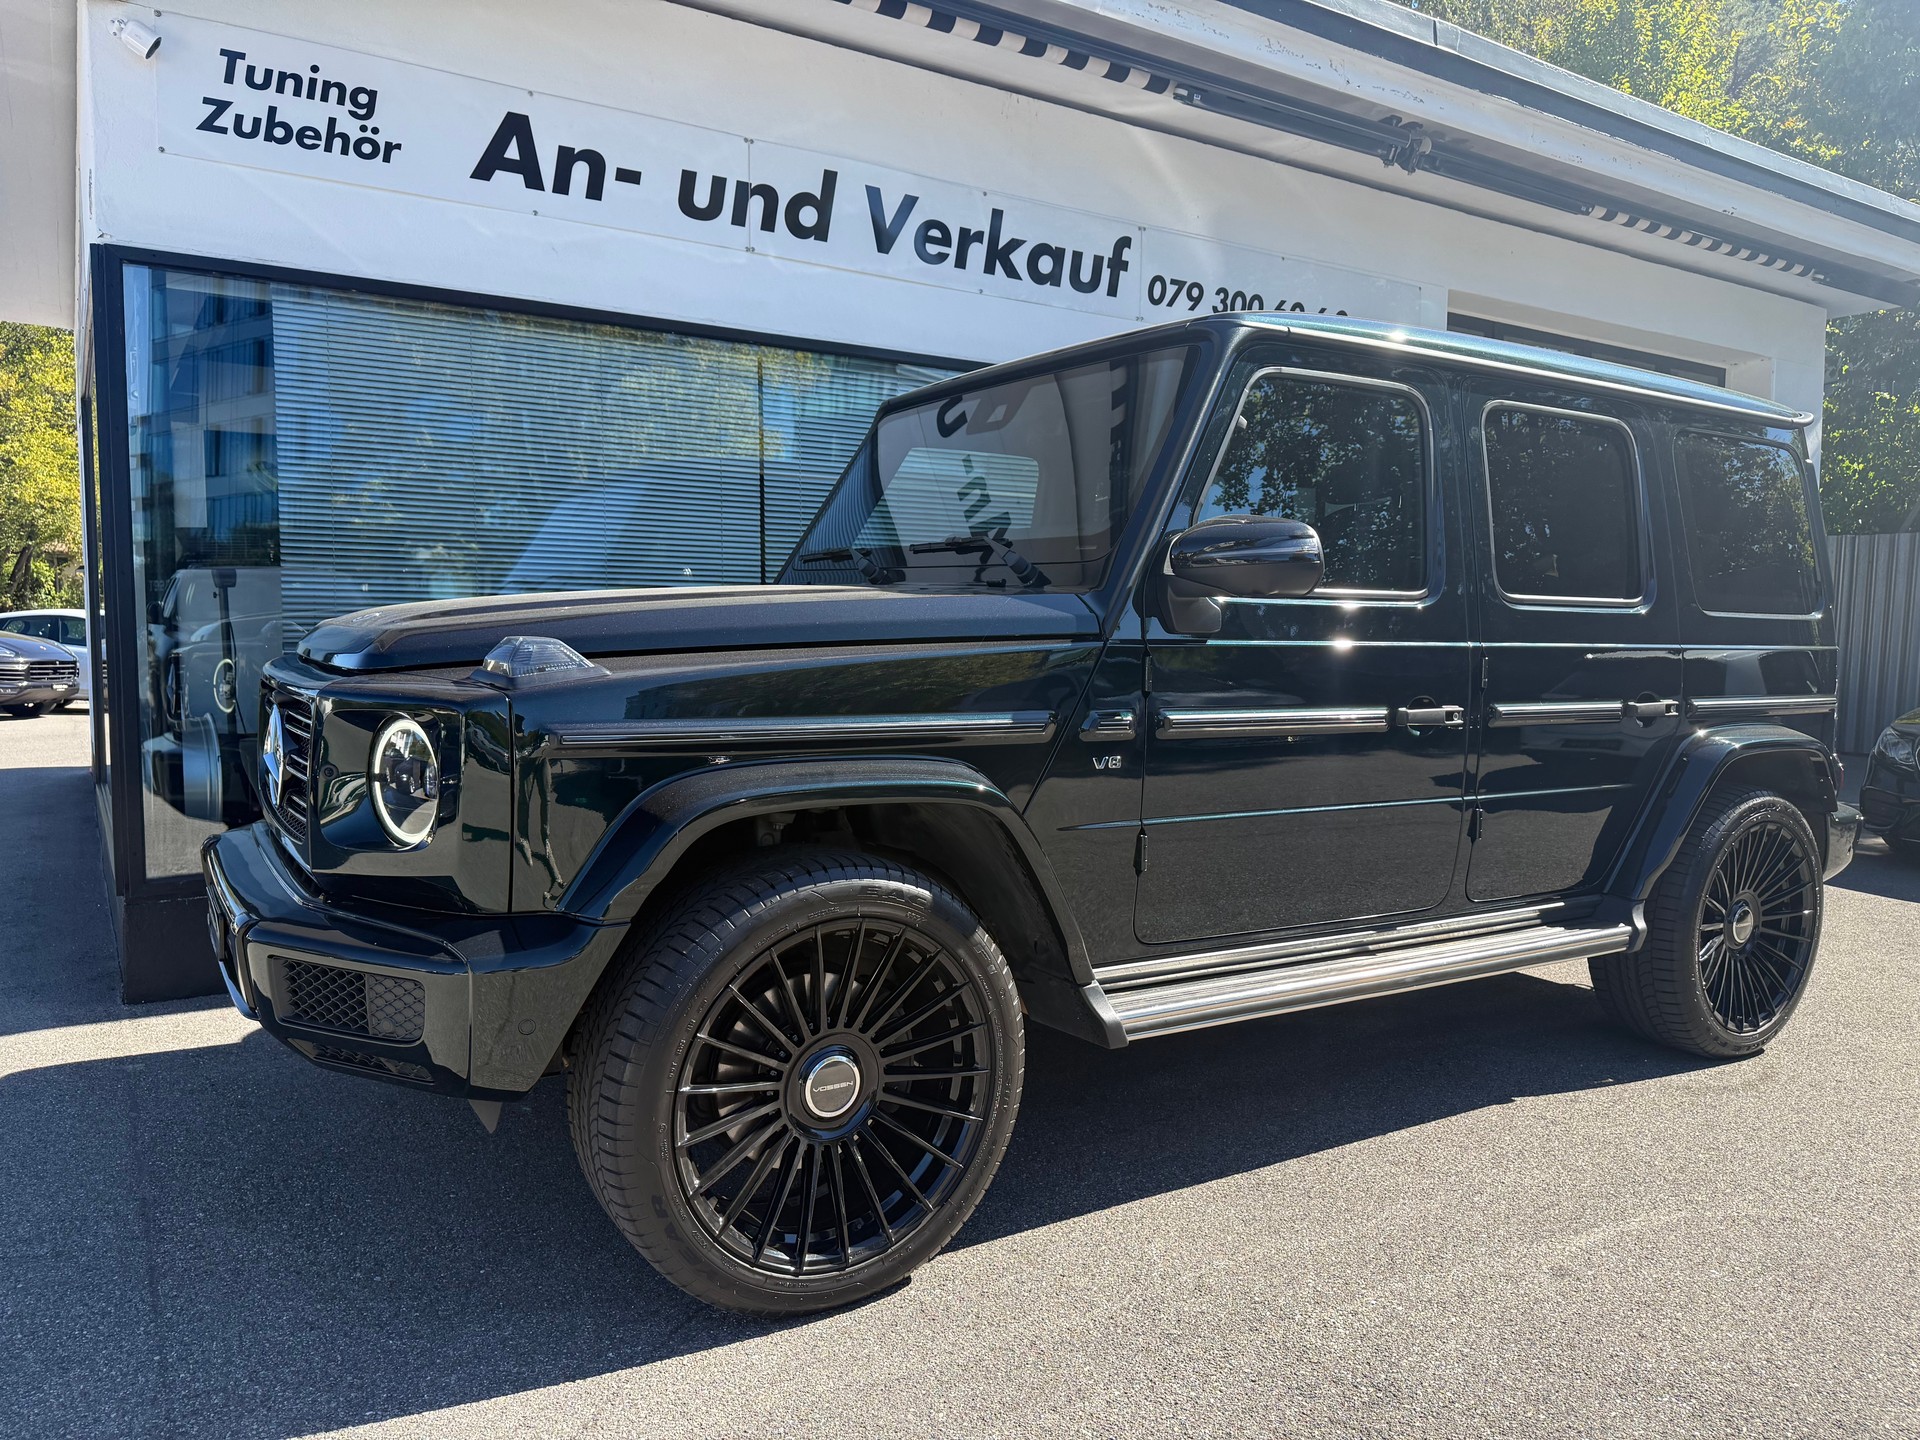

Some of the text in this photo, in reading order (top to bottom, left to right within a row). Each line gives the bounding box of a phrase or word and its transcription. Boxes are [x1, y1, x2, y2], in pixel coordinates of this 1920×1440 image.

[219, 48, 378, 121] Tuning
[195, 96, 402, 164] Zubehör
[469, 111, 1133, 298] An- und Verkauf
[1147, 274, 1205, 312] 079
[1092, 755, 1122, 770] V8
[812, 1080, 854, 1093] VOSSEN
